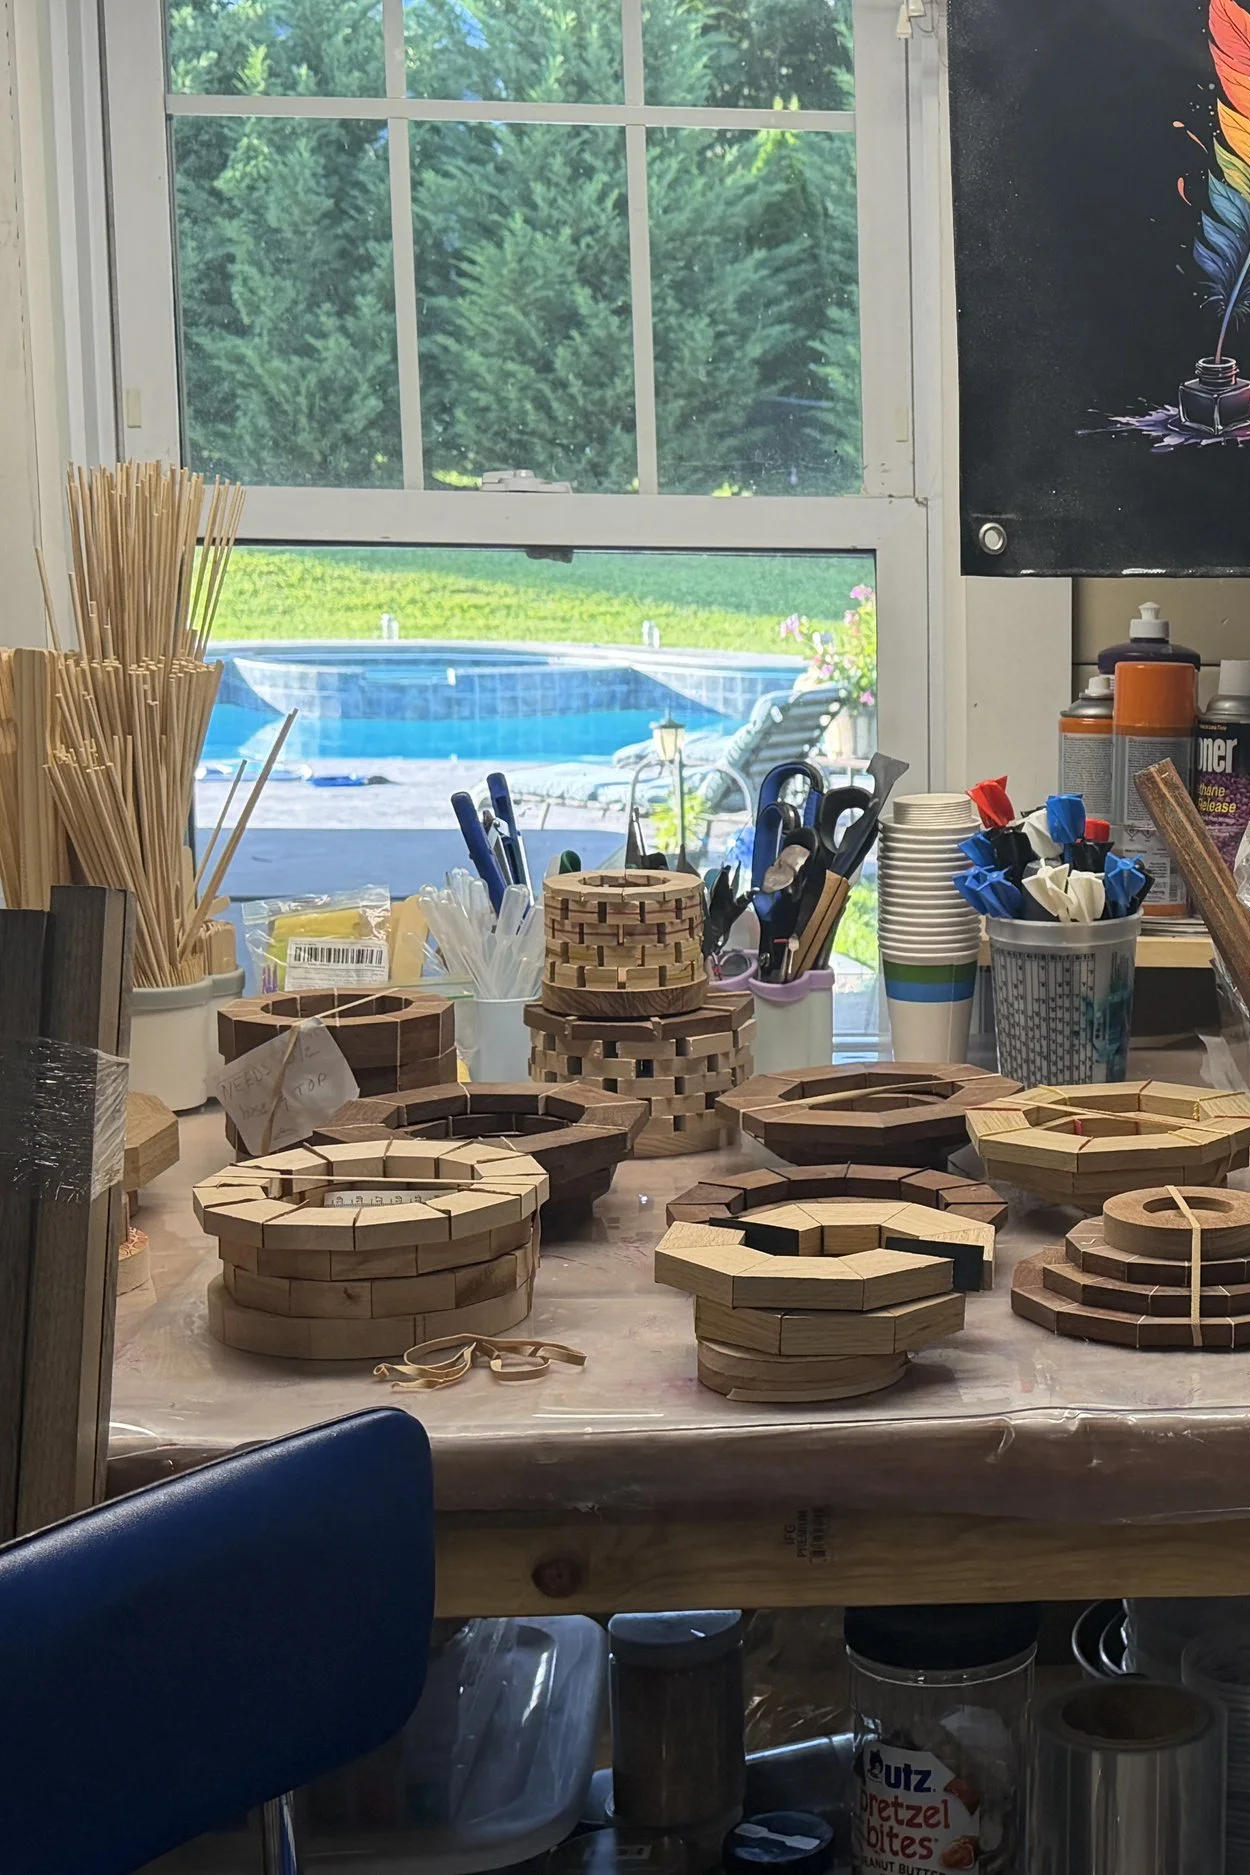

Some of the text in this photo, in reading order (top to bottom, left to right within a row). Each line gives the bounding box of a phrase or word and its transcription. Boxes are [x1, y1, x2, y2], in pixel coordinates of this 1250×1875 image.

[797, 1510, 807, 1558] PREMIUM
[860, 1786, 951, 1829] pretzel
[866, 1817, 934, 1860] bites
[862, 1855, 946, 1875] EANUT BUTTE
